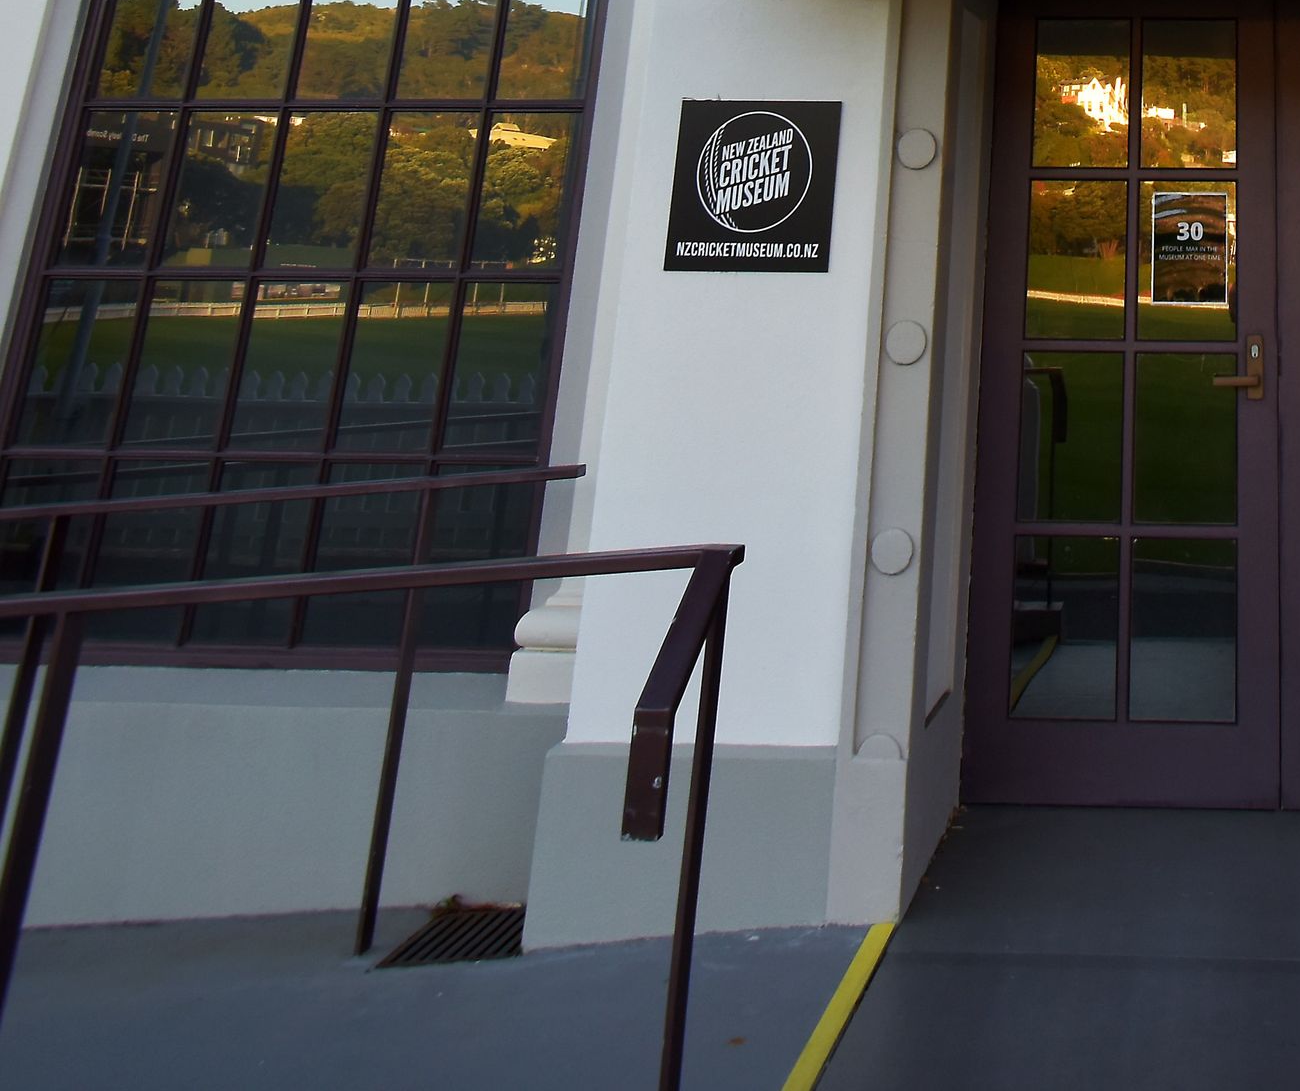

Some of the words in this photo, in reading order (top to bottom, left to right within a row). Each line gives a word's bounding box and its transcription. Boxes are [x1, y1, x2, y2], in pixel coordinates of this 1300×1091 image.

[721, 140, 746, 161] NEW
[747, 128, 794, 154] ZEALAND
[719, 144, 792, 188] CRICKET
[715, 171, 791, 215] MUSEUM
[1176, 221, 1204, 241] 30
[676, 241, 819, 258] NZCRICKETMUSEUM.CO.NZ
